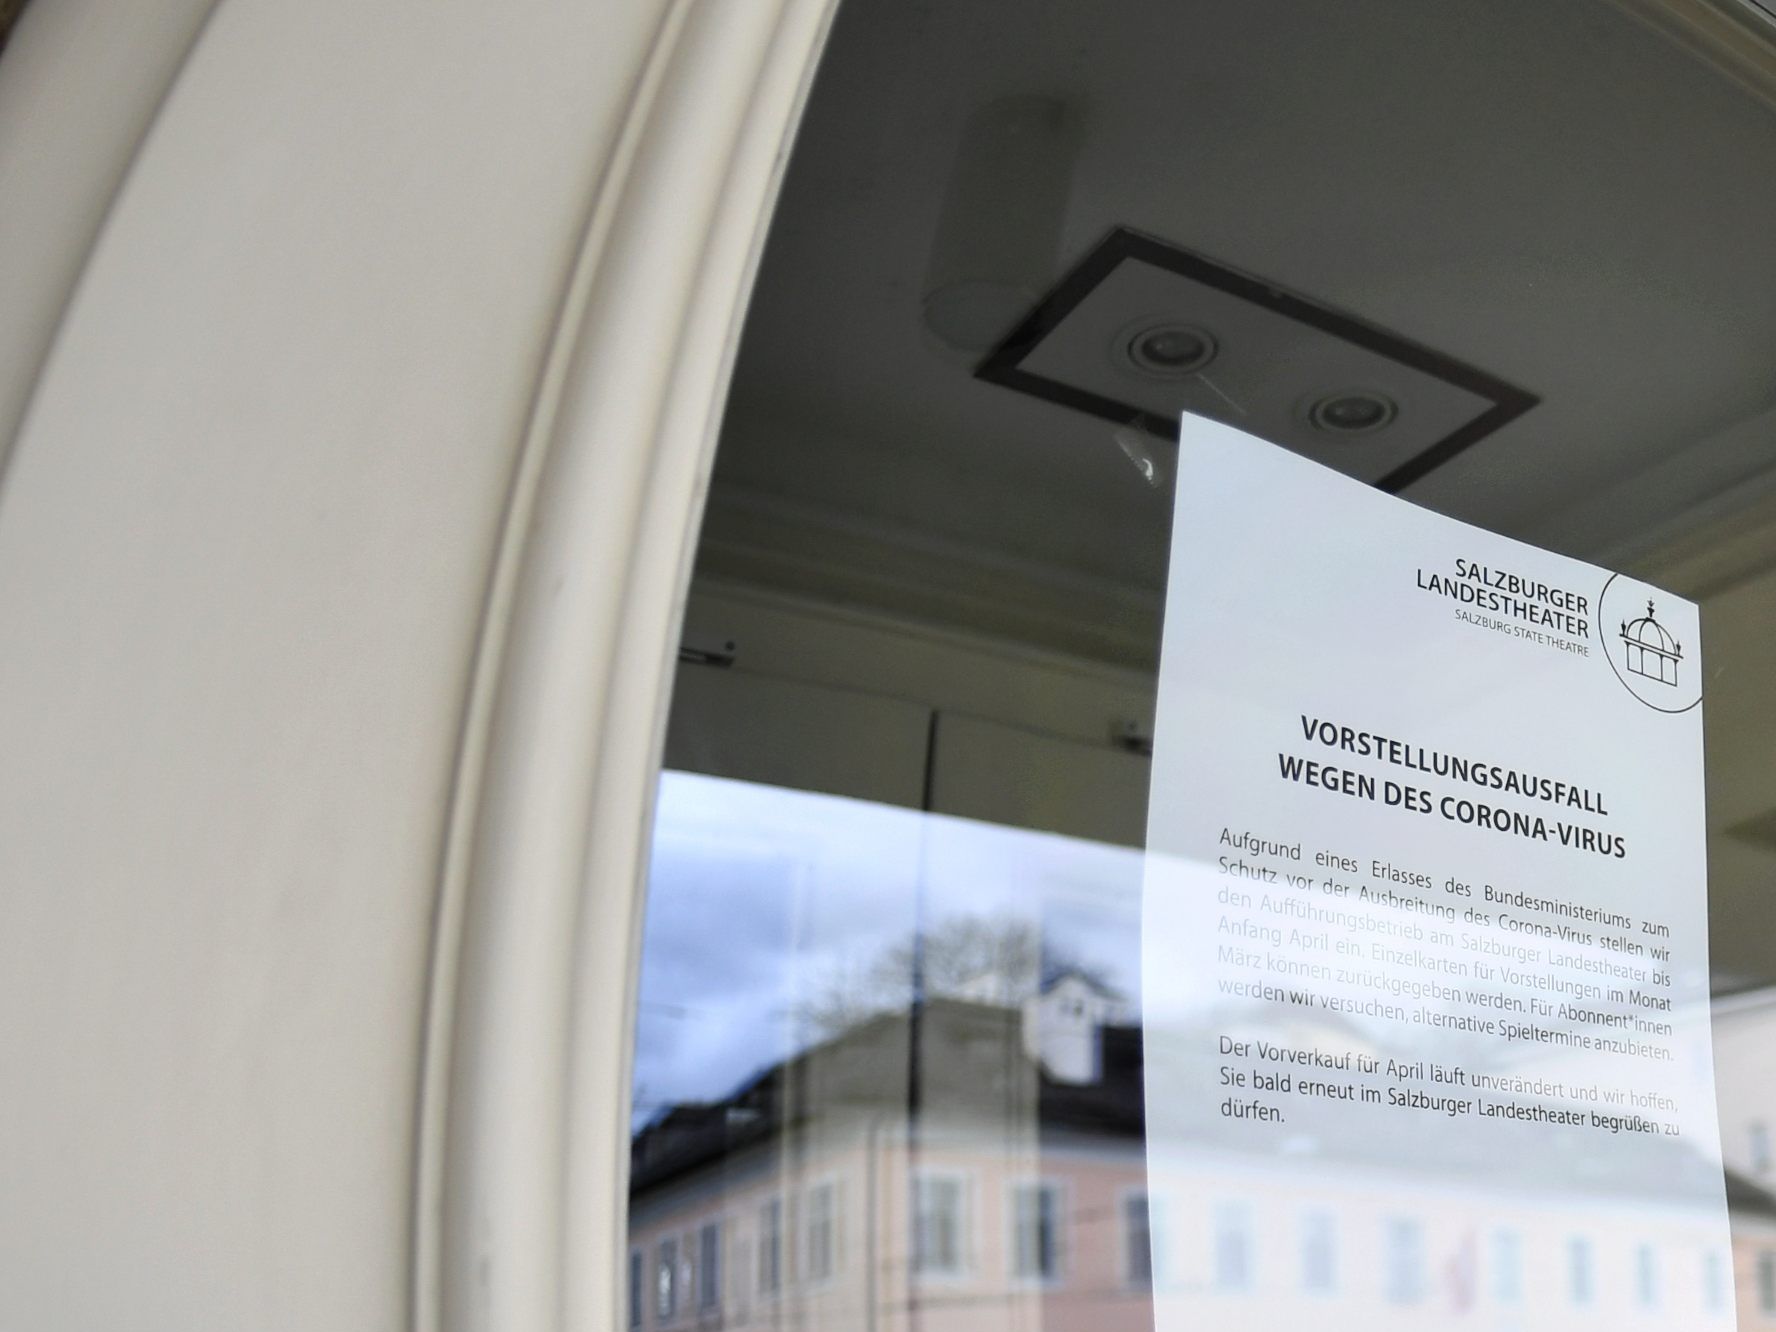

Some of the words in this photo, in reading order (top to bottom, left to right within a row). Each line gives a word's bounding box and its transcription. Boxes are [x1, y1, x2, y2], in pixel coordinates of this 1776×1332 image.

[1417, 568, 1589, 639] LANDESTHEATER
[1455, 558, 1588, 616] SALZBURGER
[1455, 609, 1511, 635] SALZBURG
[1514, 628, 1544, 644] STATE
[1546, 636, 1589, 657] THEATRE
[1301, 714, 1608, 816] VORSTELLUNGSAUSFALL
[1278, 753, 1376, 801] WEGEN
[1384, 781, 1433, 815] DES
[1440, 796, 1626, 859] CORONA-VIRUS
[1219, 856, 1277, 884] Schutz
[1287, 874, 1313, 890] vor
[1323, 878, 1350, 898] der
[1359, 885, 1455, 923] Ausbreitung
[1464, 908, 1490, 926] des
[1499, 913, 1592, 946] Corona-Virus
[1600, 934, 1643, 957] stellen
[1650, 947, 1670, 962] wir
[1220, 827, 1301, 860] Aufgrund
[1315, 850, 1358, 872] eines
[1372, 861, 1432, 888] Erlasses
[1445, 877, 1471, 897] des
[1485, 885, 1631, 929] Bundesministeriums
[1642, 920, 1670, 938] zum
[1218, 886, 1251, 908] den
[1260, 894, 1423, 941] Aufführungsbetrieb
[1430, 930, 1454, 947] am
[1461, 932, 1542, 964] Salzburger
[1549, 949, 1646, 982] Landestheater
[1652, 968, 1671, 987] bis
[1218, 915, 1282, 947] Anfang
[1289, 928, 1328, 951] April
[1372, 943, 1468, 976] Einzelkarten
[1474, 961, 1495, 981] für
[1500, 966, 1601, 1000] Vorstellungen
[1607, 985, 1624, 1003] im
[1629, 989, 1672, 1012] Monat
[1218, 945, 1262, 969] März
[1267, 952, 1331, 981] können
[1336, 966, 1461, 1002] zurückgegeben
[1466, 992, 1526, 1013] werden.
[1531, 998, 1554, 1017] Für
[1218, 979, 1285, 1002] werden
[1290, 988, 1315, 1007] wir
[1320, 995, 1409, 1024] versuchen,
[1413, 1006, 1495, 1034] alternative
[1499, 1019, 1590, 1049] Spieltermine
[1594, 1037, 1674, 1062] anzubieten.
[1219, 1035, 1251, 1057] Der
[1257, 1040, 1351, 1070] Vorverkauf
[1357, 1053, 1380, 1074] für
[1387, 1059, 1424, 1082] April
[1430, 1063, 1465, 1086] läuft
[1471, 1073, 1564, 1098] unverändert
[1570, 1085, 1598, 1101] und
[1603, 1088, 1624, 1104] wir
[1630, 1090, 1679, 1113] hoffen,
[1220, 1066, 1246, 1087] Sie
[1253, 1069, 1291, 1092] bald
[1298, 1080, 1354, 1101] erneut
[1361, 1084, 1381, 1103] im
[1388, 1087, 1472, 1117] Salzburger
[1478, 1099, 1586, 1126] Landestheater
[1591, 1110, 1660, 1134] begrüßen
[1664, 1122, 1680, 1136] zu
[1221, 1098, 1285, 1123] dürfen.
